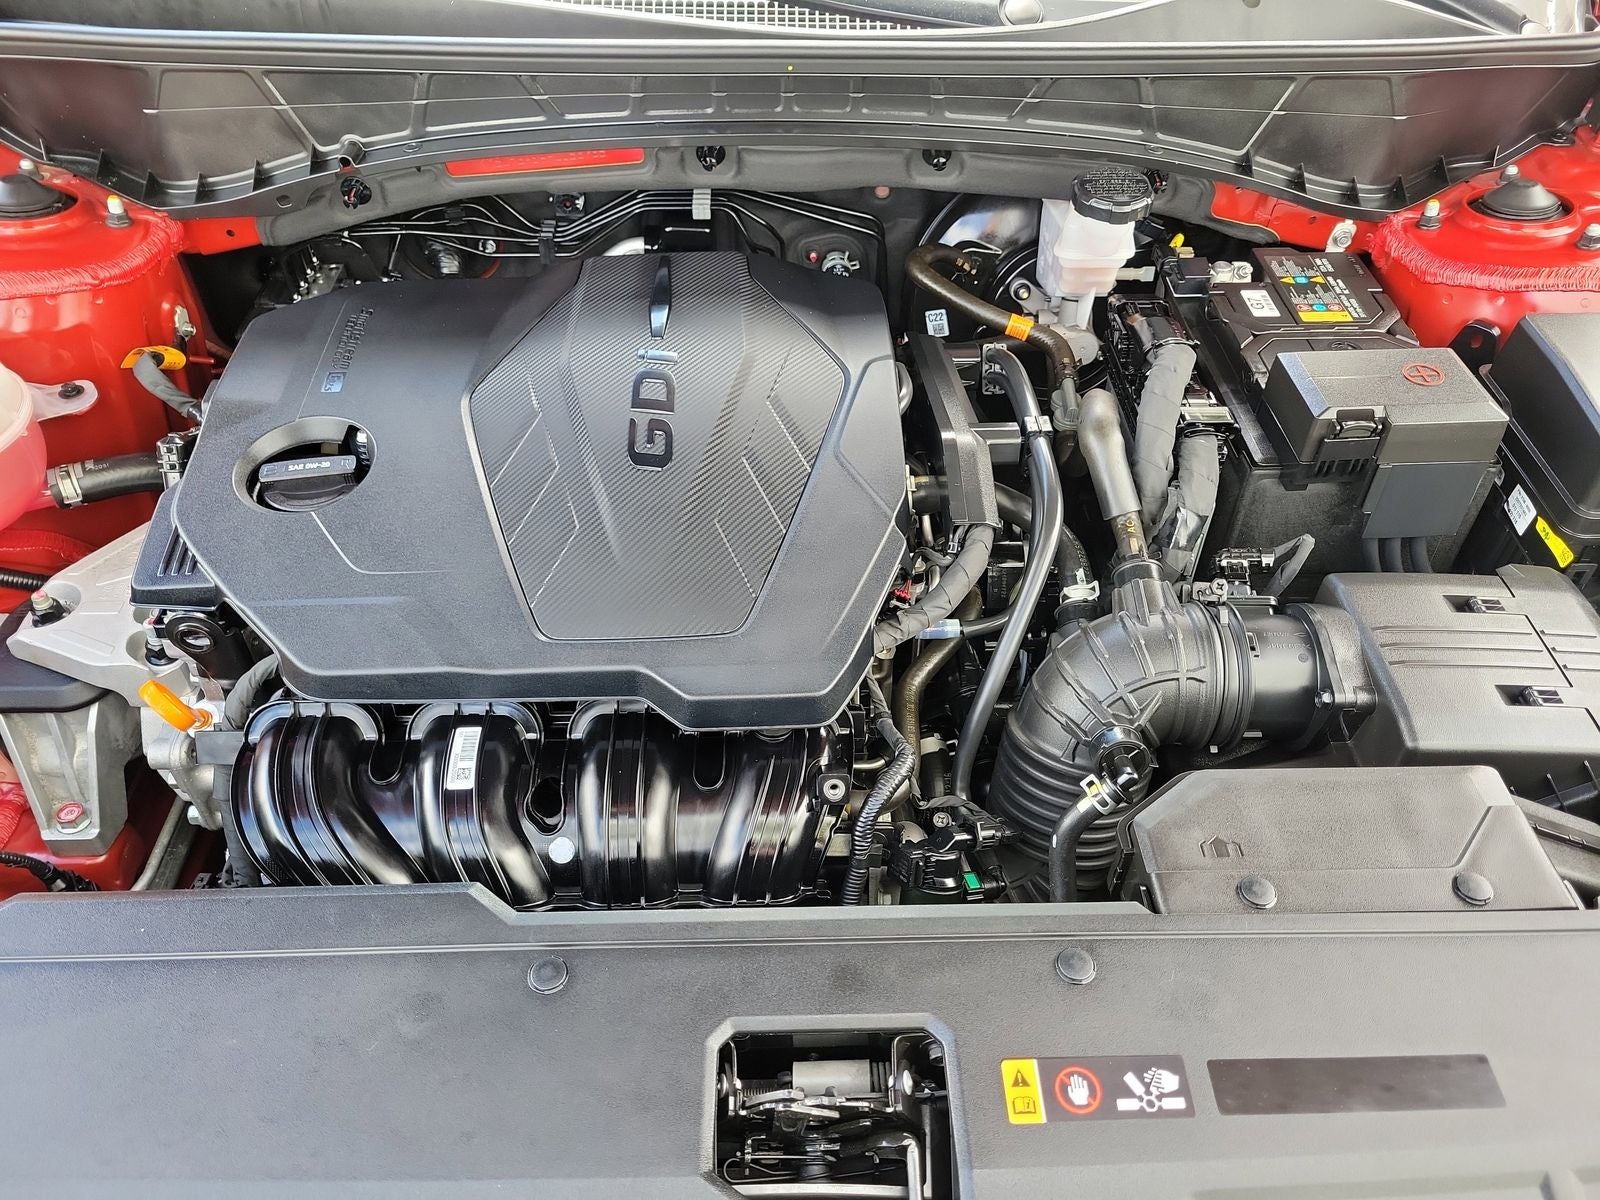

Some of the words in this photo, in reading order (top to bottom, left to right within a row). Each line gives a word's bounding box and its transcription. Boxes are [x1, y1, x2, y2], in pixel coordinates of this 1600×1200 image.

[1247, 297, 1265, 310] G7
[928, 312, 944, 323] C22
[627, 348, 678, 471] GDi
[305, 461, 331, 470] 0W-20
